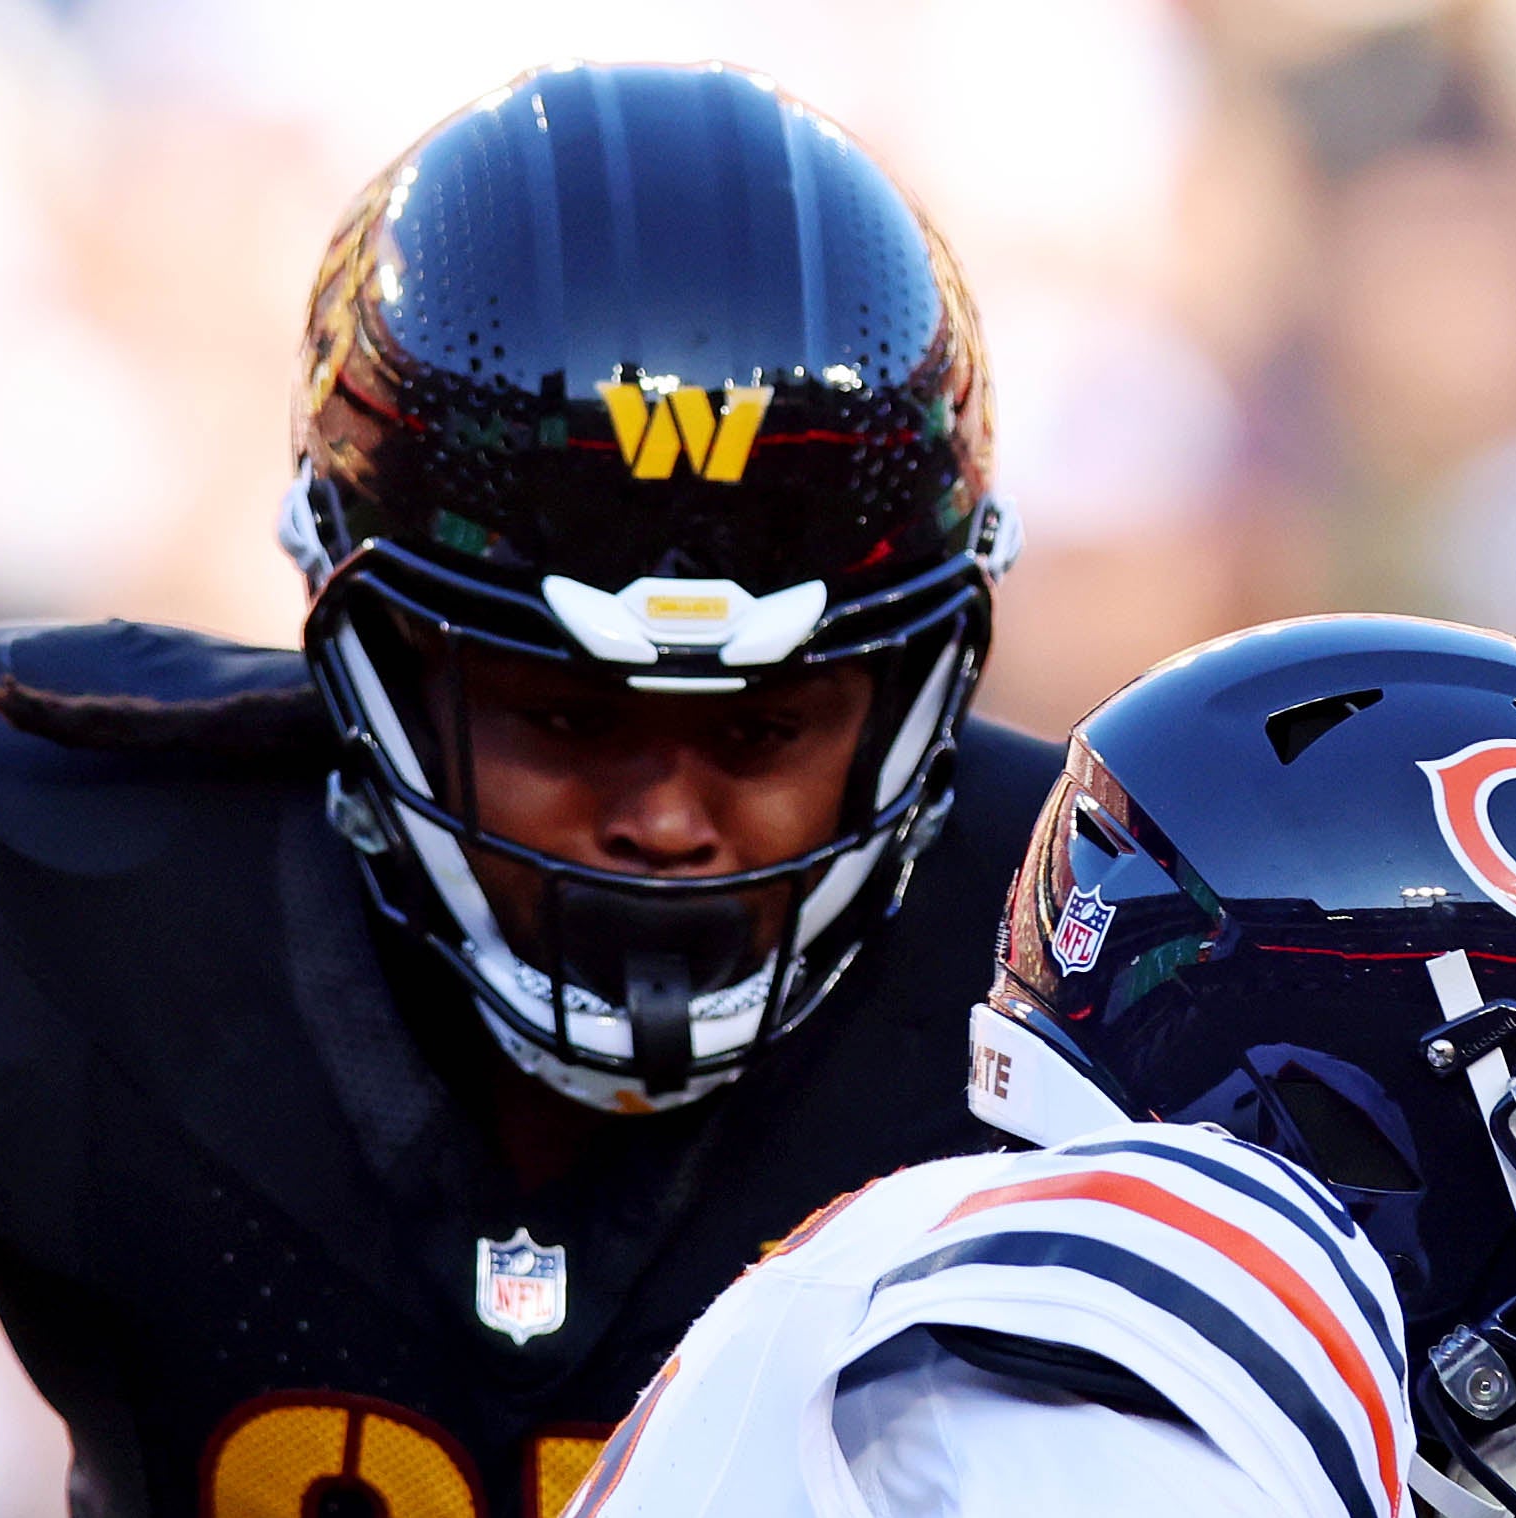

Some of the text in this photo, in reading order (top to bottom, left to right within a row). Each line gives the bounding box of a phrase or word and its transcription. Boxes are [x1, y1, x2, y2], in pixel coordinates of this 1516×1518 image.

[595, 381, 775, 483] W
[1059, 919, 1093, 963] NFL
[493, 1276, 553, 1321] NFL
